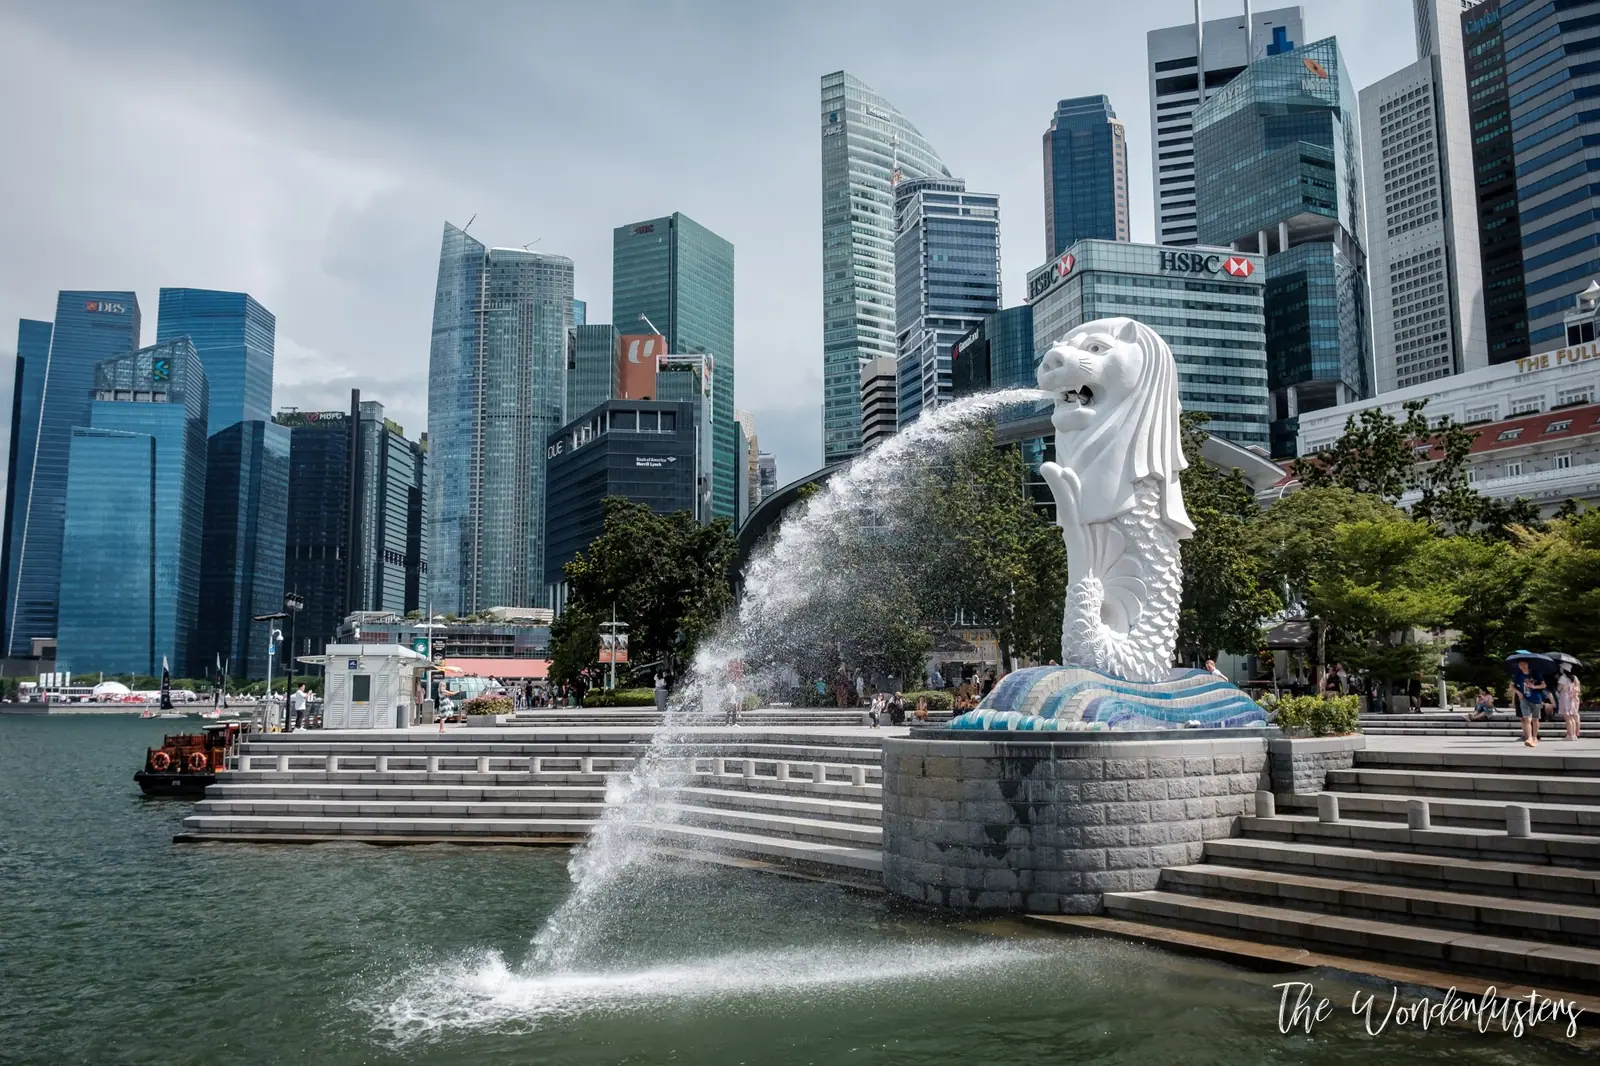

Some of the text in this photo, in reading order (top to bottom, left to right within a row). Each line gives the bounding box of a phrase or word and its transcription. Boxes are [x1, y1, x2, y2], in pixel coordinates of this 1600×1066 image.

[1160, 250, 1221, 275] HSBC
[1028, 262, 1060, 301] HSBC
[98, 301, 126, 314] DBS
[1514, 343, 1600, 373] THE FULL
[319, 411, 343, 420] MUFG
[547, 440, 565, 460] OUE
